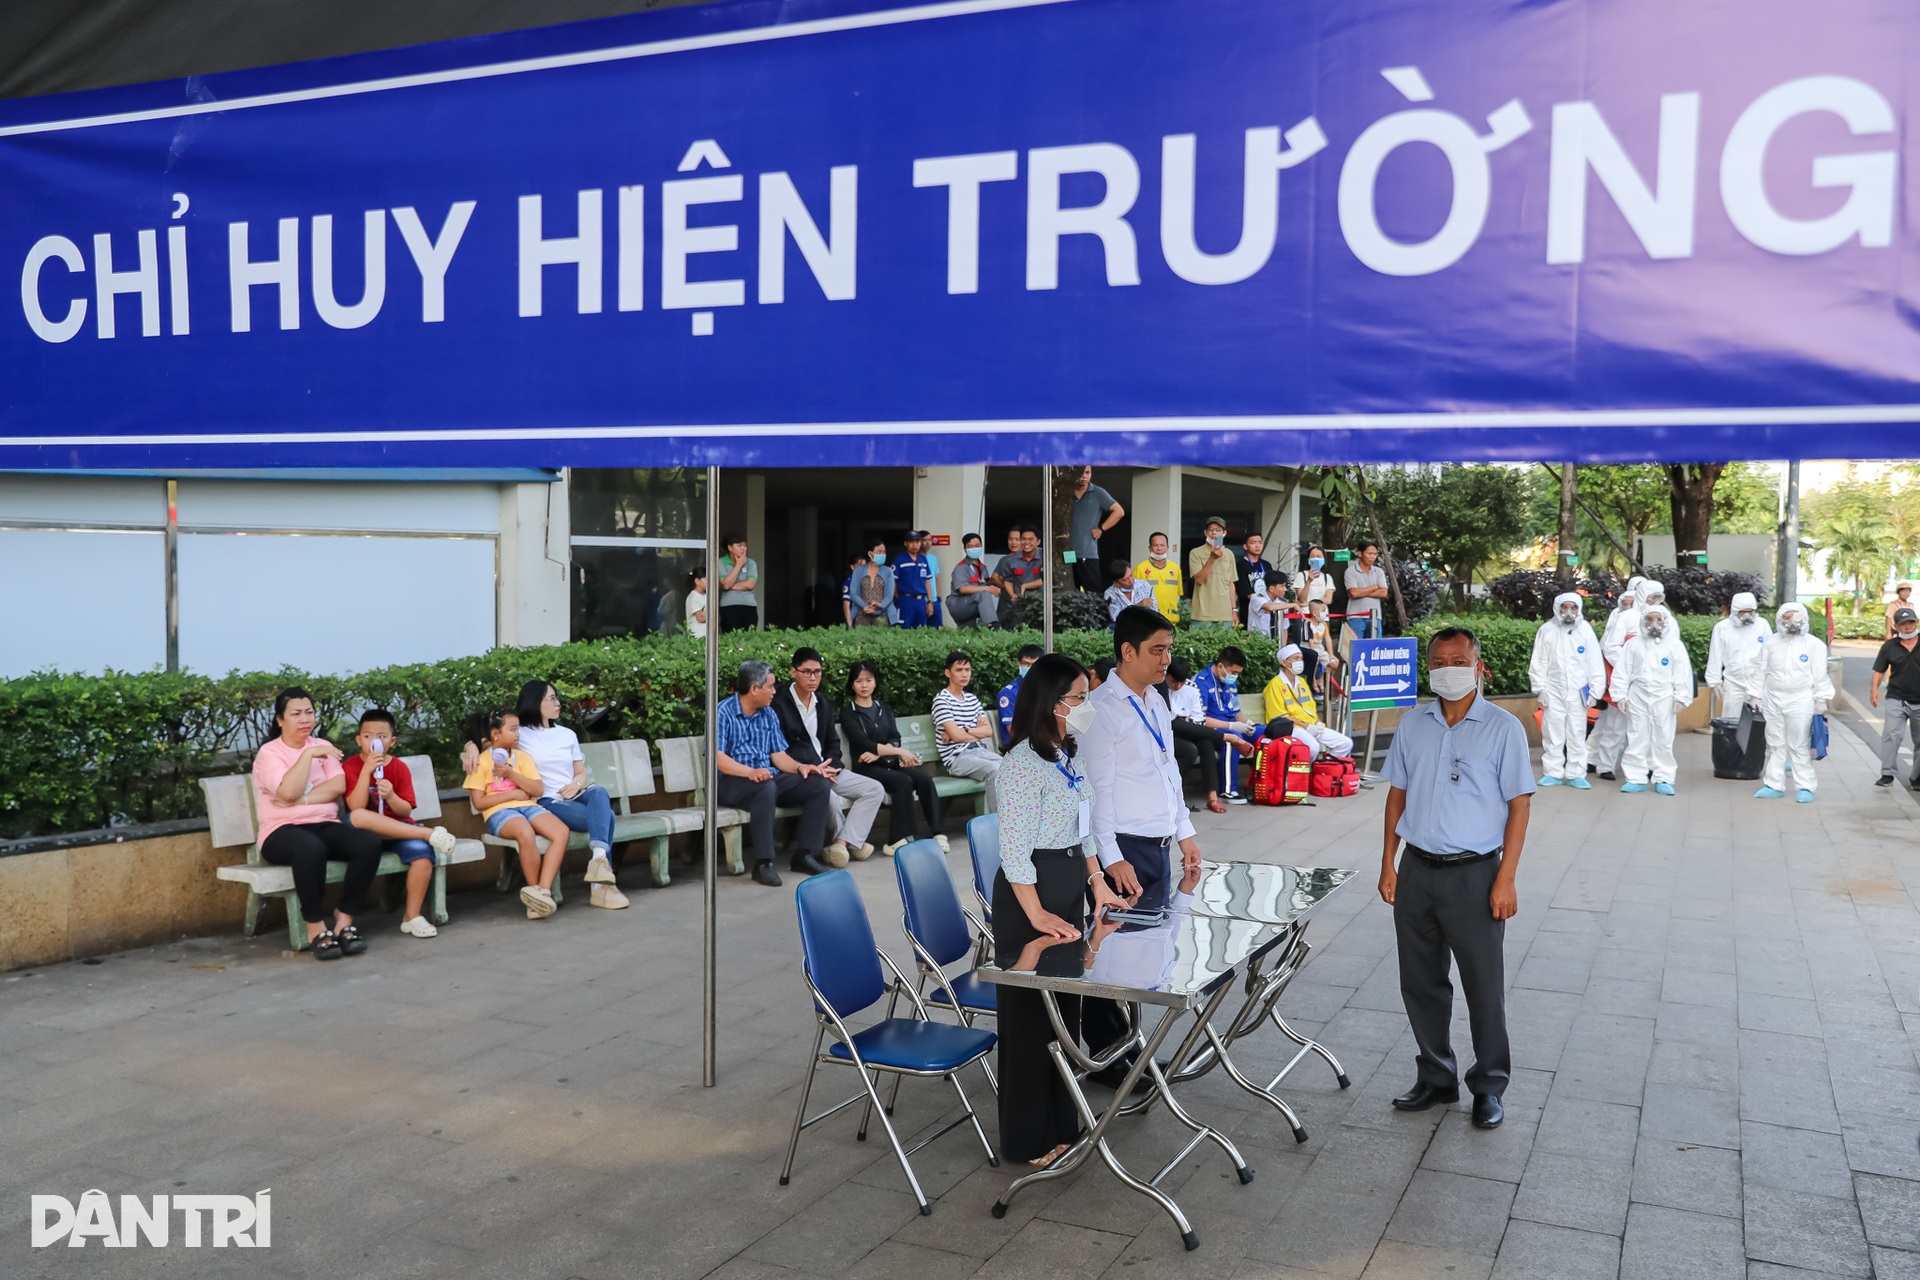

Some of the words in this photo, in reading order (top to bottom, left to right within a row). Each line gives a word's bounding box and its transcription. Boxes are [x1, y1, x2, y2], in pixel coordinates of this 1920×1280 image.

[20, 192, 191, 343] CHỈ
[228, 200, 477, 333] HUY
[518, 138, 858, 336] HIỆN
[912, 65, 1899, 295] TRƯỜNG
